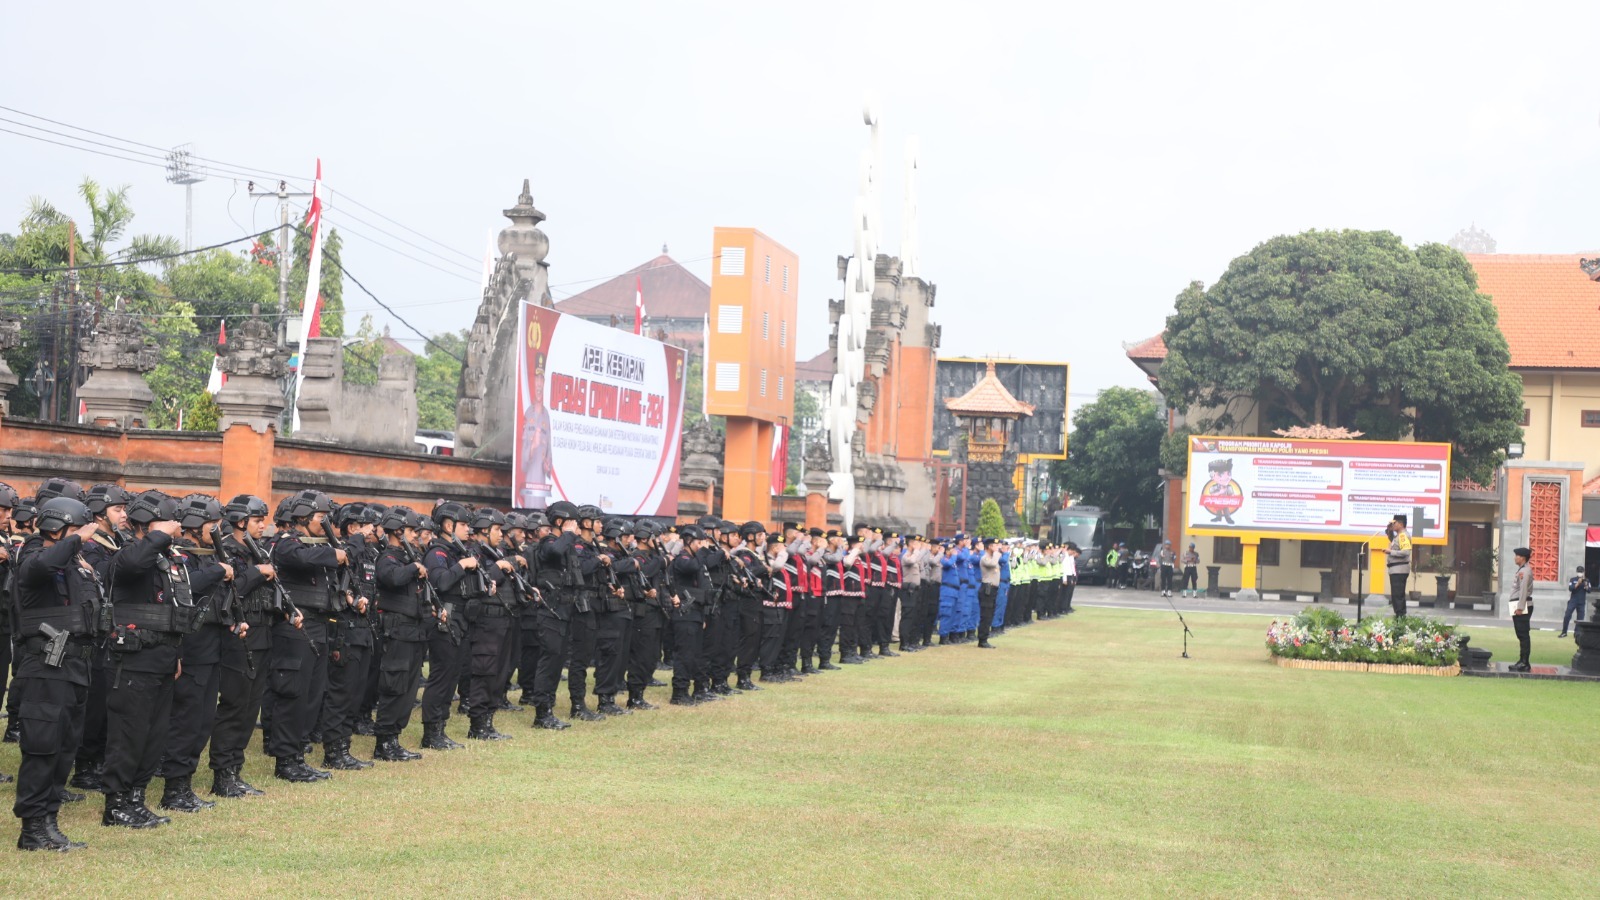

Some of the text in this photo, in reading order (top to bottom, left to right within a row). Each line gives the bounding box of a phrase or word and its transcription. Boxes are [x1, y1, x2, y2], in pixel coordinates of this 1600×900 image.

[581, 346, 645, 384] APEL KESIAPAN
[550, 372, 588, 417] OPERASI
[1218, 440, 1242, 448] PROGRAM
[1243, 441, 1269, 449] PRIORITAS
